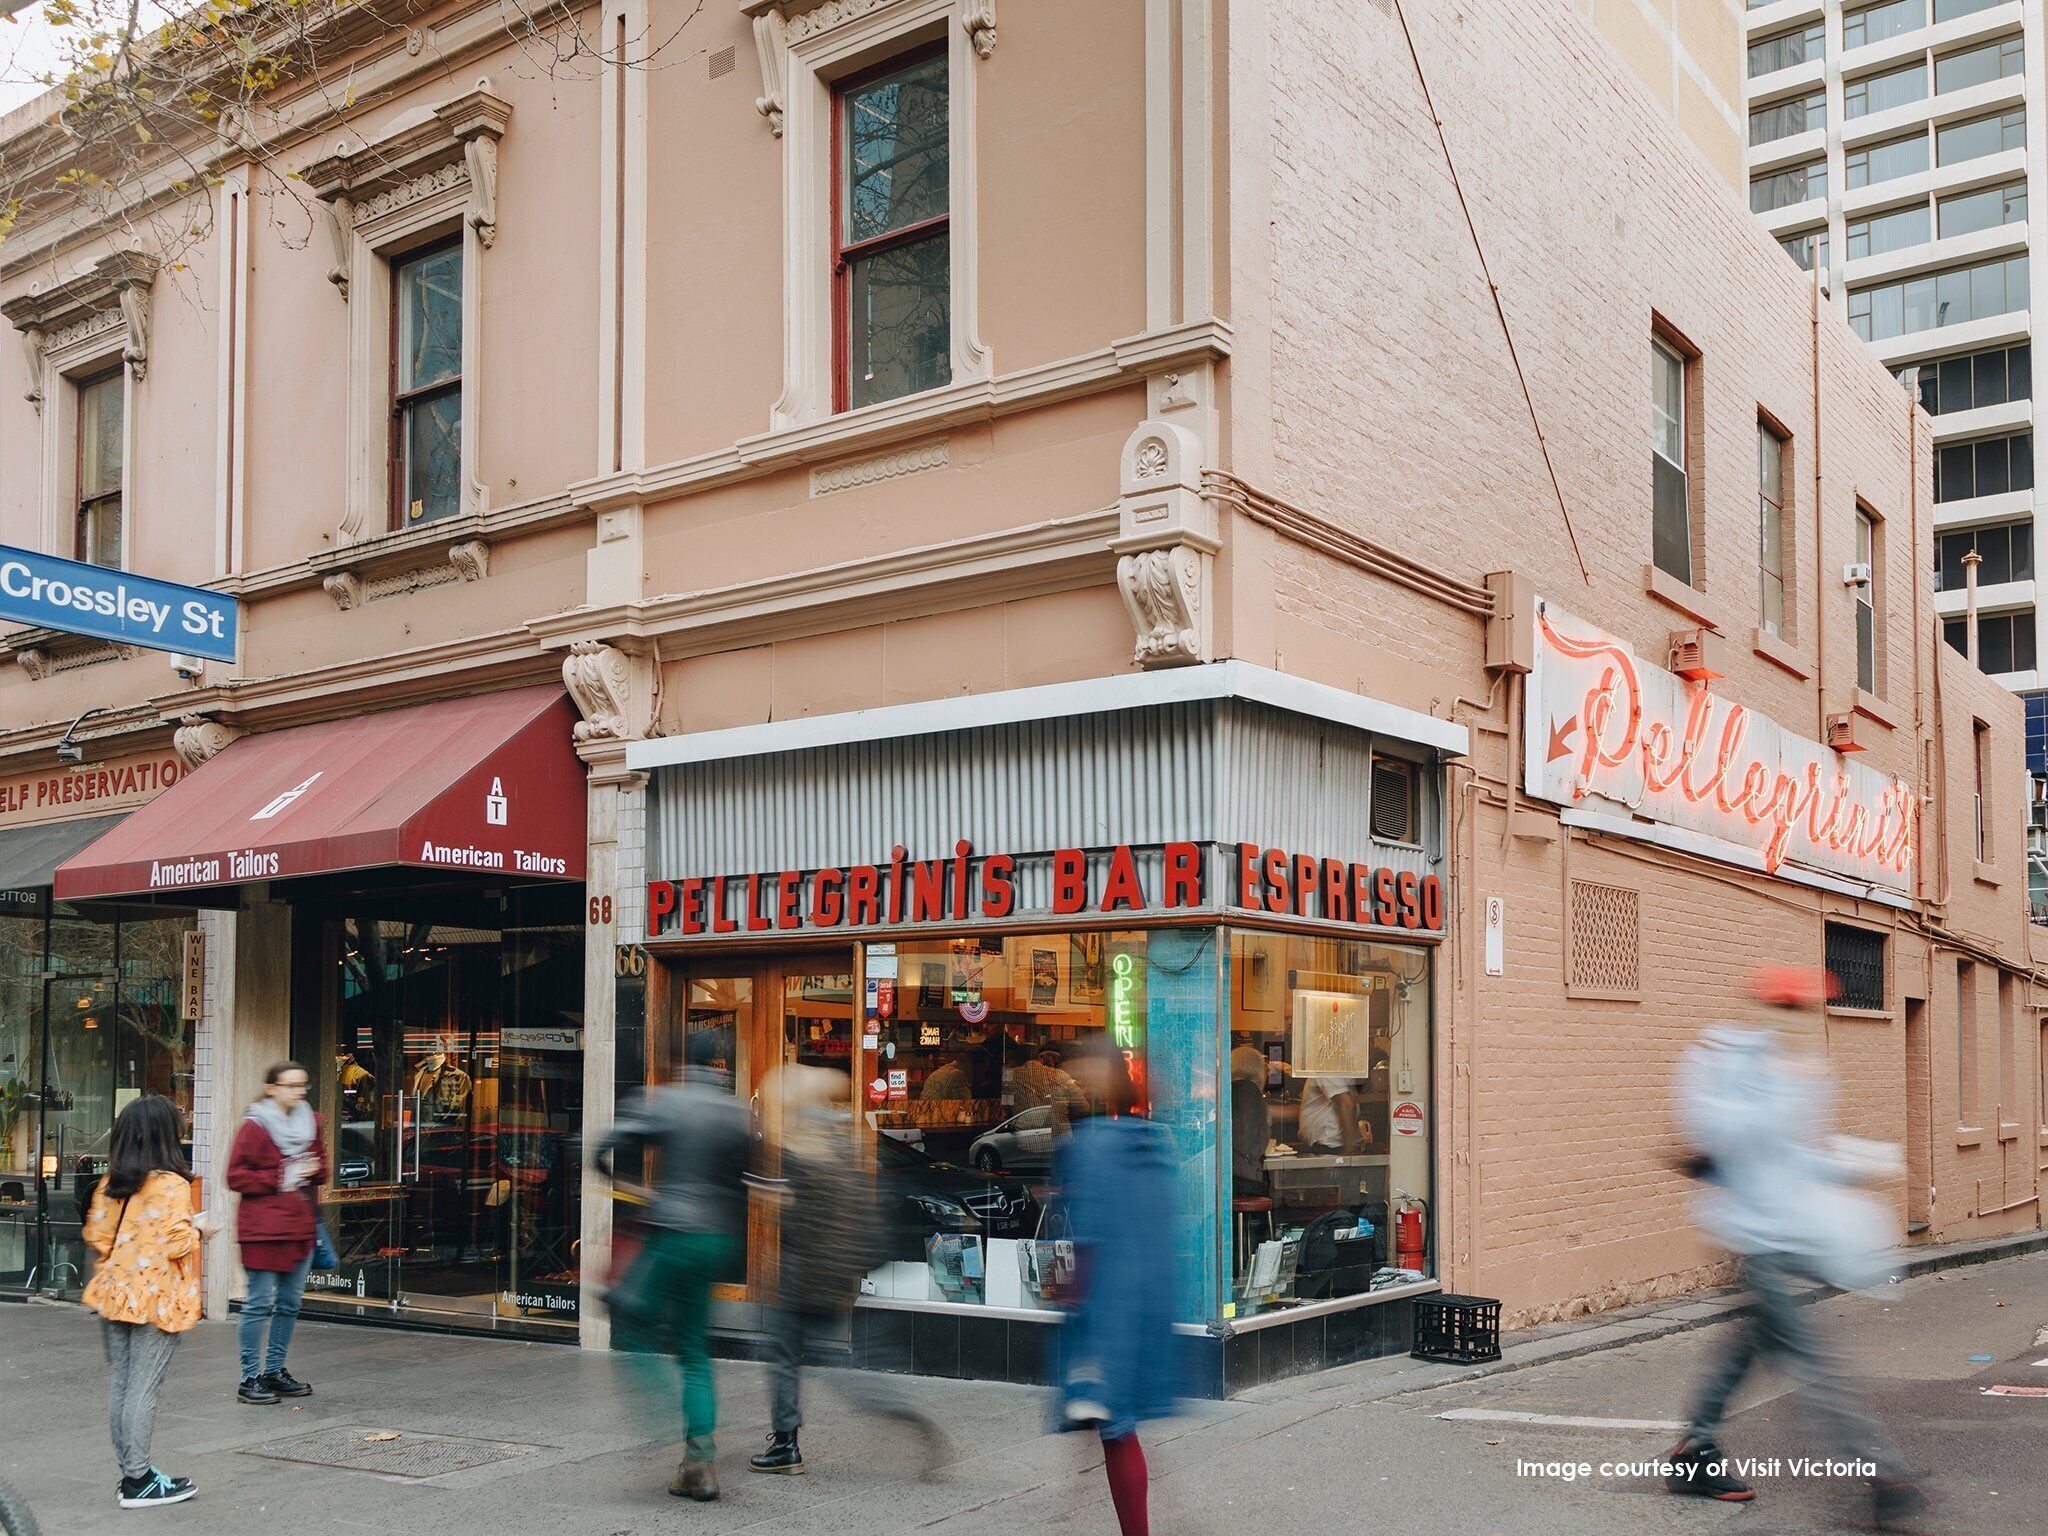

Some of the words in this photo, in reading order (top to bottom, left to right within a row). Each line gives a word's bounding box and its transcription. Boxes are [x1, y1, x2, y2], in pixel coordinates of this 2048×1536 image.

[0, 561, 171, 633] Crossley
[182, 601, 225, 639] St
[149, 856, 220, 888] American
[227, 849, 280, 879] Tailors
[420, 841, 504, 868] American
[513, 849, 566, 874] Tailors
[1052, 841, 1203, 914] BAR
[1236, 842, 1444, 931] ESPRESSO
[589, 895, 612, 925] 68
[189, 934, 202, 978] WINE
[615, 943, 644, 976] 66
[189, 985, 199, 1017] BAR
[1112, 953, 1134, 1048] OPEN
[304, 1272, 326, 1286] rican
[326, 1273, 352, 1288] Tailors
[501, 1290, 543, 1307] American
[545, 1294, 576, 1310] Tailors
